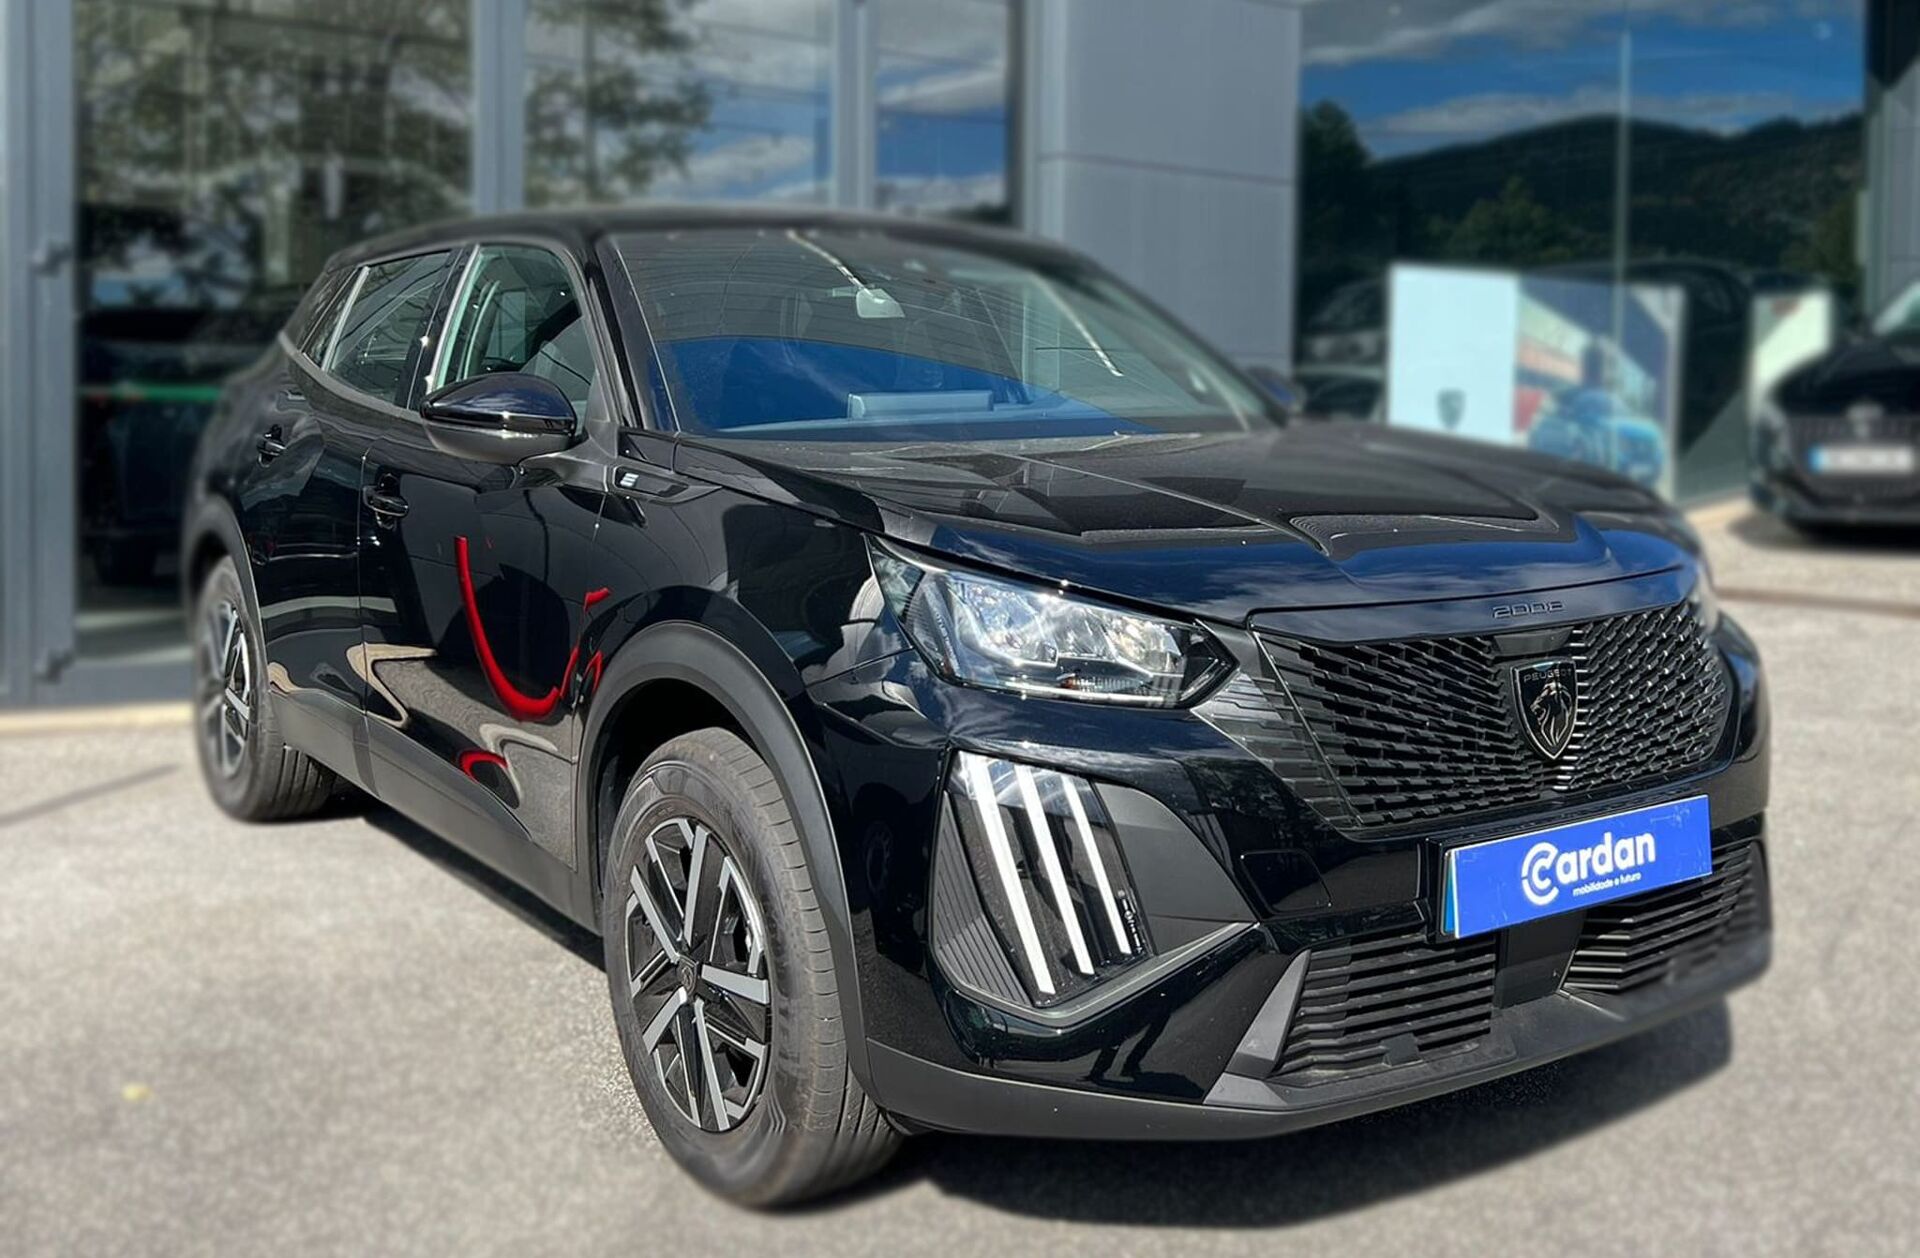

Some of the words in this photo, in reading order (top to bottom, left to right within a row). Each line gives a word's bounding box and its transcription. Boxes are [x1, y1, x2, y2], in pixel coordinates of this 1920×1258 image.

[1523, 668, 1572, 683] PEUGEOT
[1521, 831, 1656, 906] Cardan
[1572, 879, 1614, 897] mobilidade
[1619, 872, 1642, 885] futuro
